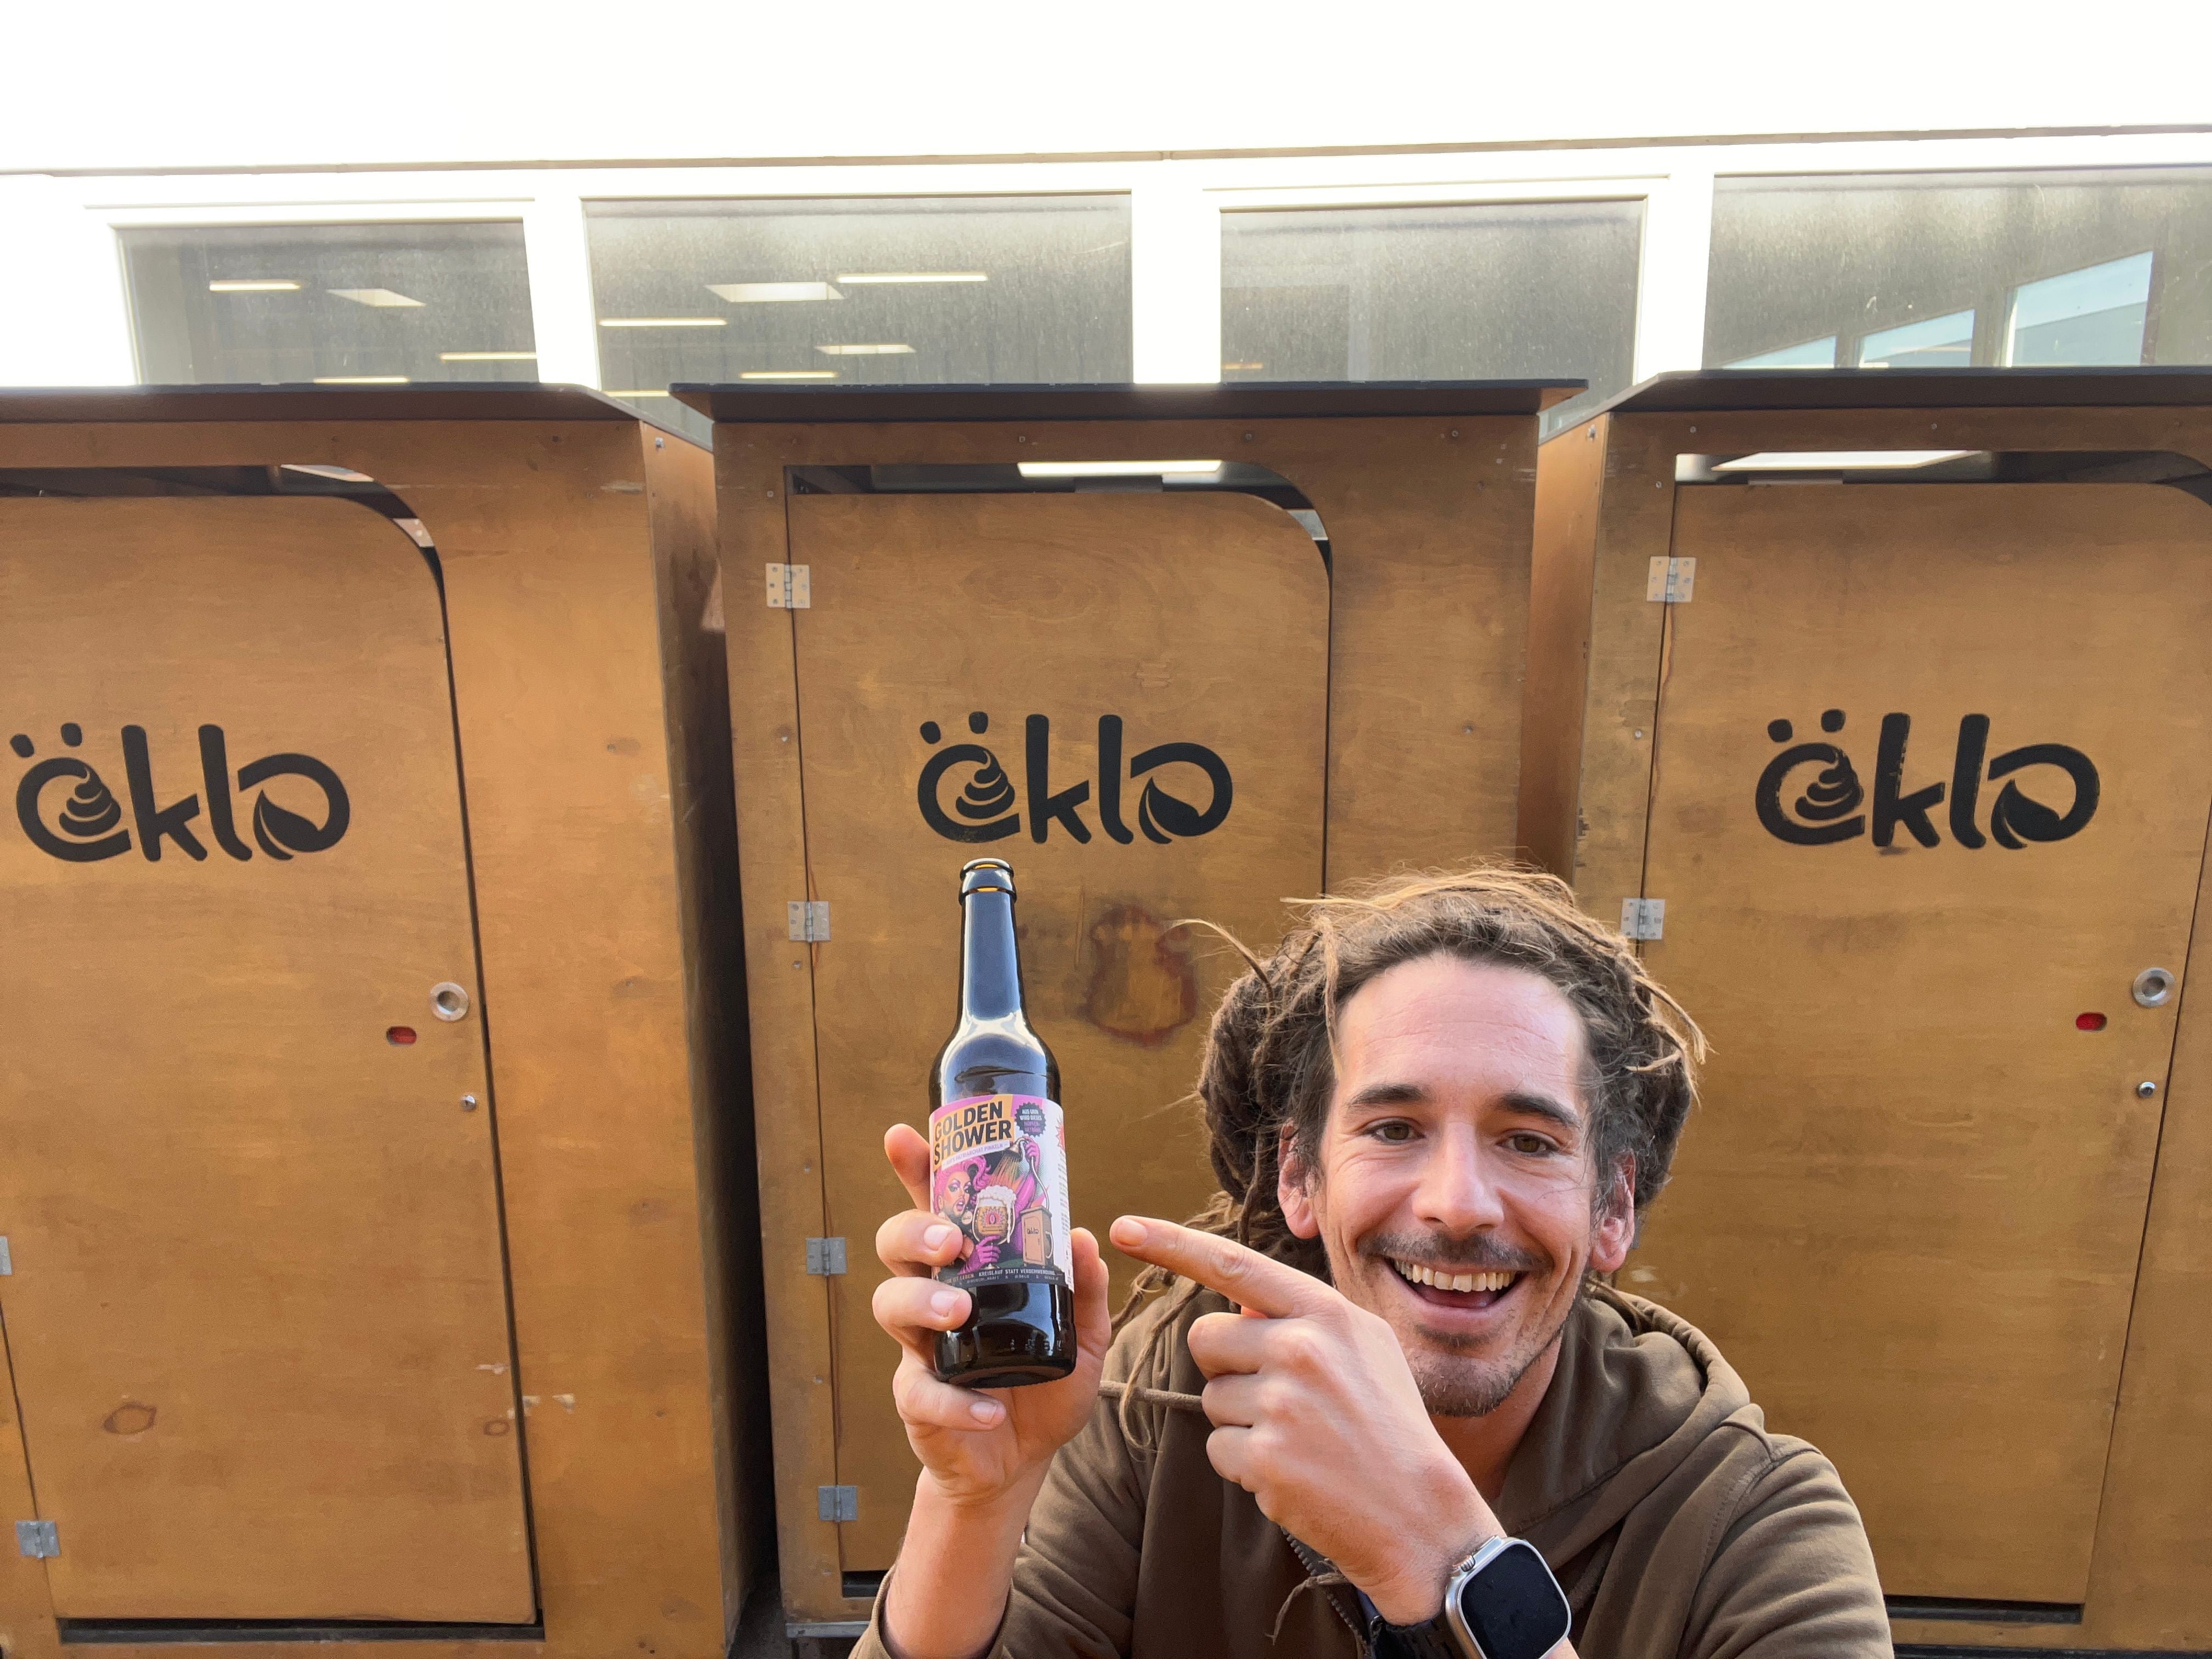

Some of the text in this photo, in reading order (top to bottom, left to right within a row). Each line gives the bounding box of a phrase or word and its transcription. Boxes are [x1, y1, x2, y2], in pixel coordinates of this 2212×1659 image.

[935, 1101, 1003, 1142] GOLDEN
[934, 1120, 1012, 1165] SHOWER
[984, 1143, 1003, 1152] PINKELN
